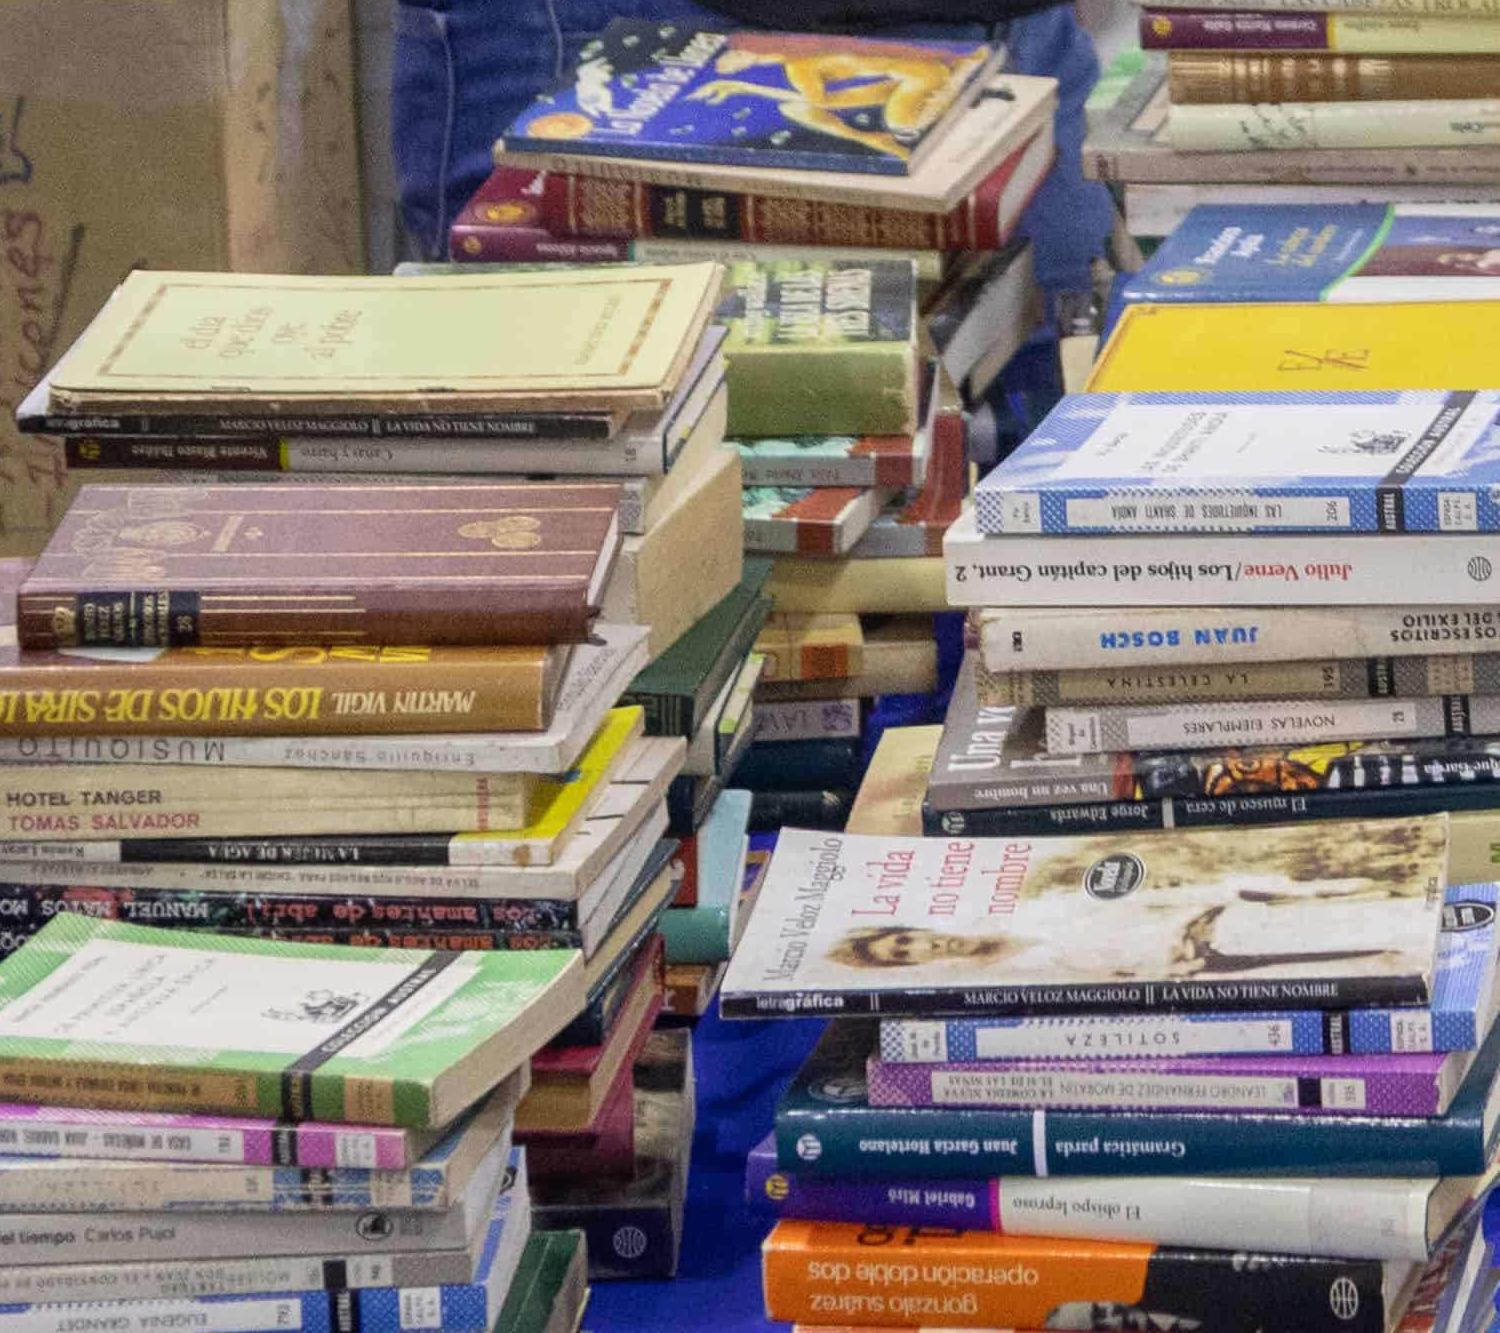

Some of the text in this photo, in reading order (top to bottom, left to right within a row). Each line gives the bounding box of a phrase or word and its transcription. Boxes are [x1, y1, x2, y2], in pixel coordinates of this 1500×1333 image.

[386, 419, 402, 433] LA
[403, 419, 432, 433] VIDA
[434, 419, 453, 433] NO
[486, 419, 536, 434] NOMBRE
[955, 561, 1353, 589] Julio Verne/Los hijos del capitán Grant, 2
[1402, 614, 1460, 629] EXILIO
[1465, 612, 1499, 627] DEL
[1100, 626, 1259, 649] JUAN BOSCH
[1391, 626, 1477, 642] ESCRITOS
[1106, 672, 1250, 691] LA CELESTINA
[27, 690, 97, 724] SIRA
[108, 688, 152, 722] DE
[161, 686, 257, 722] HIJOS
[264, 687, 323, 720] LOS
[332, 692, 385, 714] VIGIL
[392, 690, 476, 714] MARTIN
[1183, 713, 1335, 732] NOVELAS EJEMPLARES
[17, 737, 225, 762] MUSIQUITO
[947, 730, 1009, 772] Una
[6, 789, 161, 807] HOTEL TANGER
[974, 782, 1109, 801] Una vez un hombre
[1223, 797, 1242, 812] de
[1245, 797, 1289, 813] museo
[1291, 796, 1308, 811] El
[9, 812, 200, 832] TOMAS SALVADOR
[1050, 805, 1149, 824] Jorge Edwards
[254, 844, 279, 861] DE
[338, 844, 360, 861] LA
[851, 847, 915, 918] La vida
[928, 839, 976, 917] no tiene
[986, 840, 1034, 918] nombre
[41, 896, 112, 918] MATOS
[122, 899, 210, 920] MANUEL
[332, 903, 366, 925] de
[371, 904, 479, 924] amantes
[762, 921, 806, 983] Marcio
[807, 835, 845, 899] Maggiolo
[756, 992, 845, 1011] letragráfica
[964, 983, 1339, 1006] MARCIO VELOZ MAGGIOLO LA VIDA NO TIENE NOMBRE
[1066, 1030, 1181, 1047] SOTILEZA
[1118, 1082, 1133, 1095] DE
[1210, 1084, 1267, 1098] LEANDRO
[859, 1136, 932, 1155] Hortelano
[983, 1137, 1020, 1156] Juan
[1054, 1137, 1094, 1157] parda
[1099, 1136, 1186, 1158] Gramática
[924, 1192, 976, 1210] Gabriel
[1012, 1197, 1069, 1218] leproso
[1073, 1200, 1119, 1220] obispo
[1122, 1203, 1142, 1221] El
[18, 1229, 77, 1250] tiempo
[83, 1226, 135, 1244] Carlos
[138, 1224, 177, 1247] Pujol
[807, 1258, 1040, 1286] operación doble dos
[809, 1292, 979, 1317] gonzalo suárez
[57, 1312, 208, 1332] EUGENIA GRANDET
